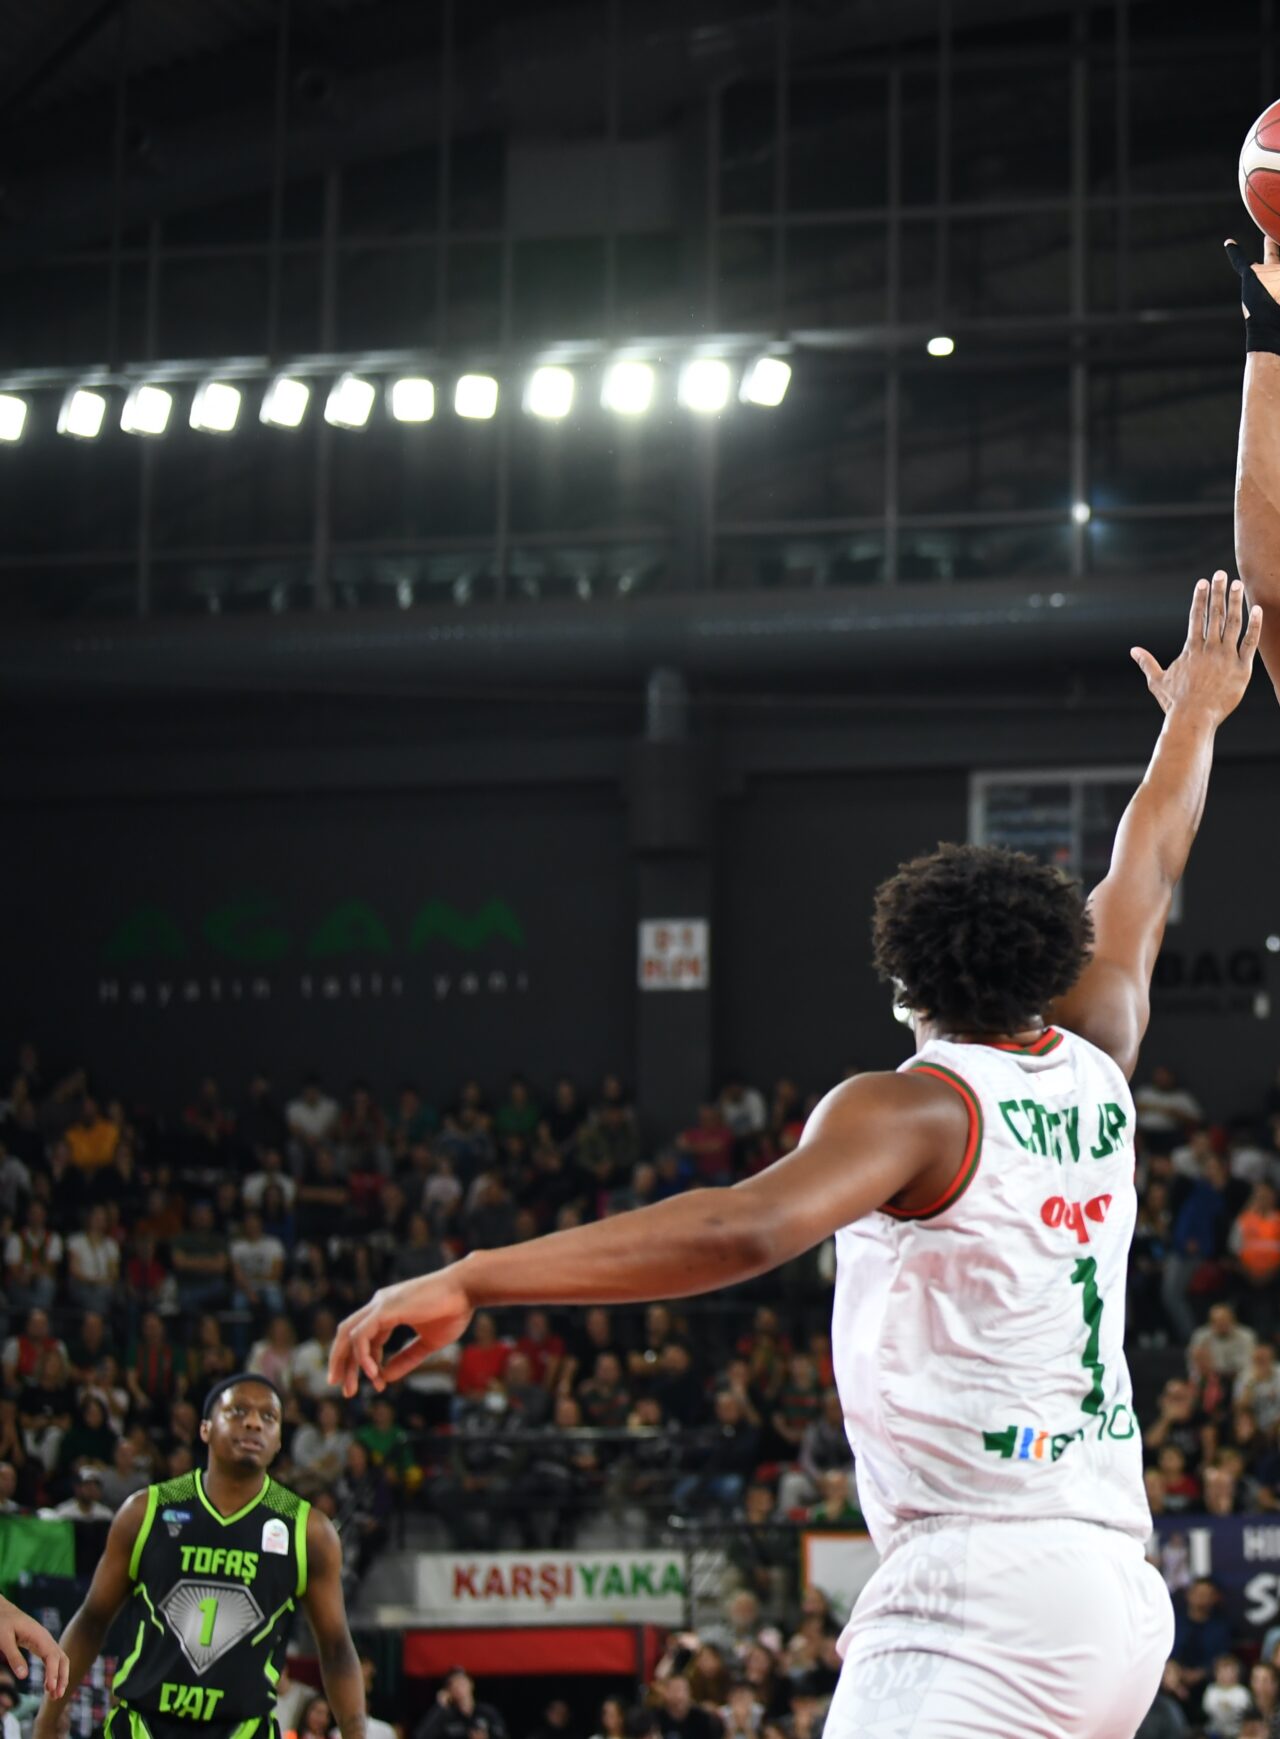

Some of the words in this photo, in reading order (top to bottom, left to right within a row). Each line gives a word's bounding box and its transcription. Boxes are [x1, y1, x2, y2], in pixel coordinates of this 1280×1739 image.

[180, 1545, 259, 1587] TOFAŞ
[453, 1562, 684, 1608] KARŞIYAKA
[198, 1596, 219, 1647] 1
